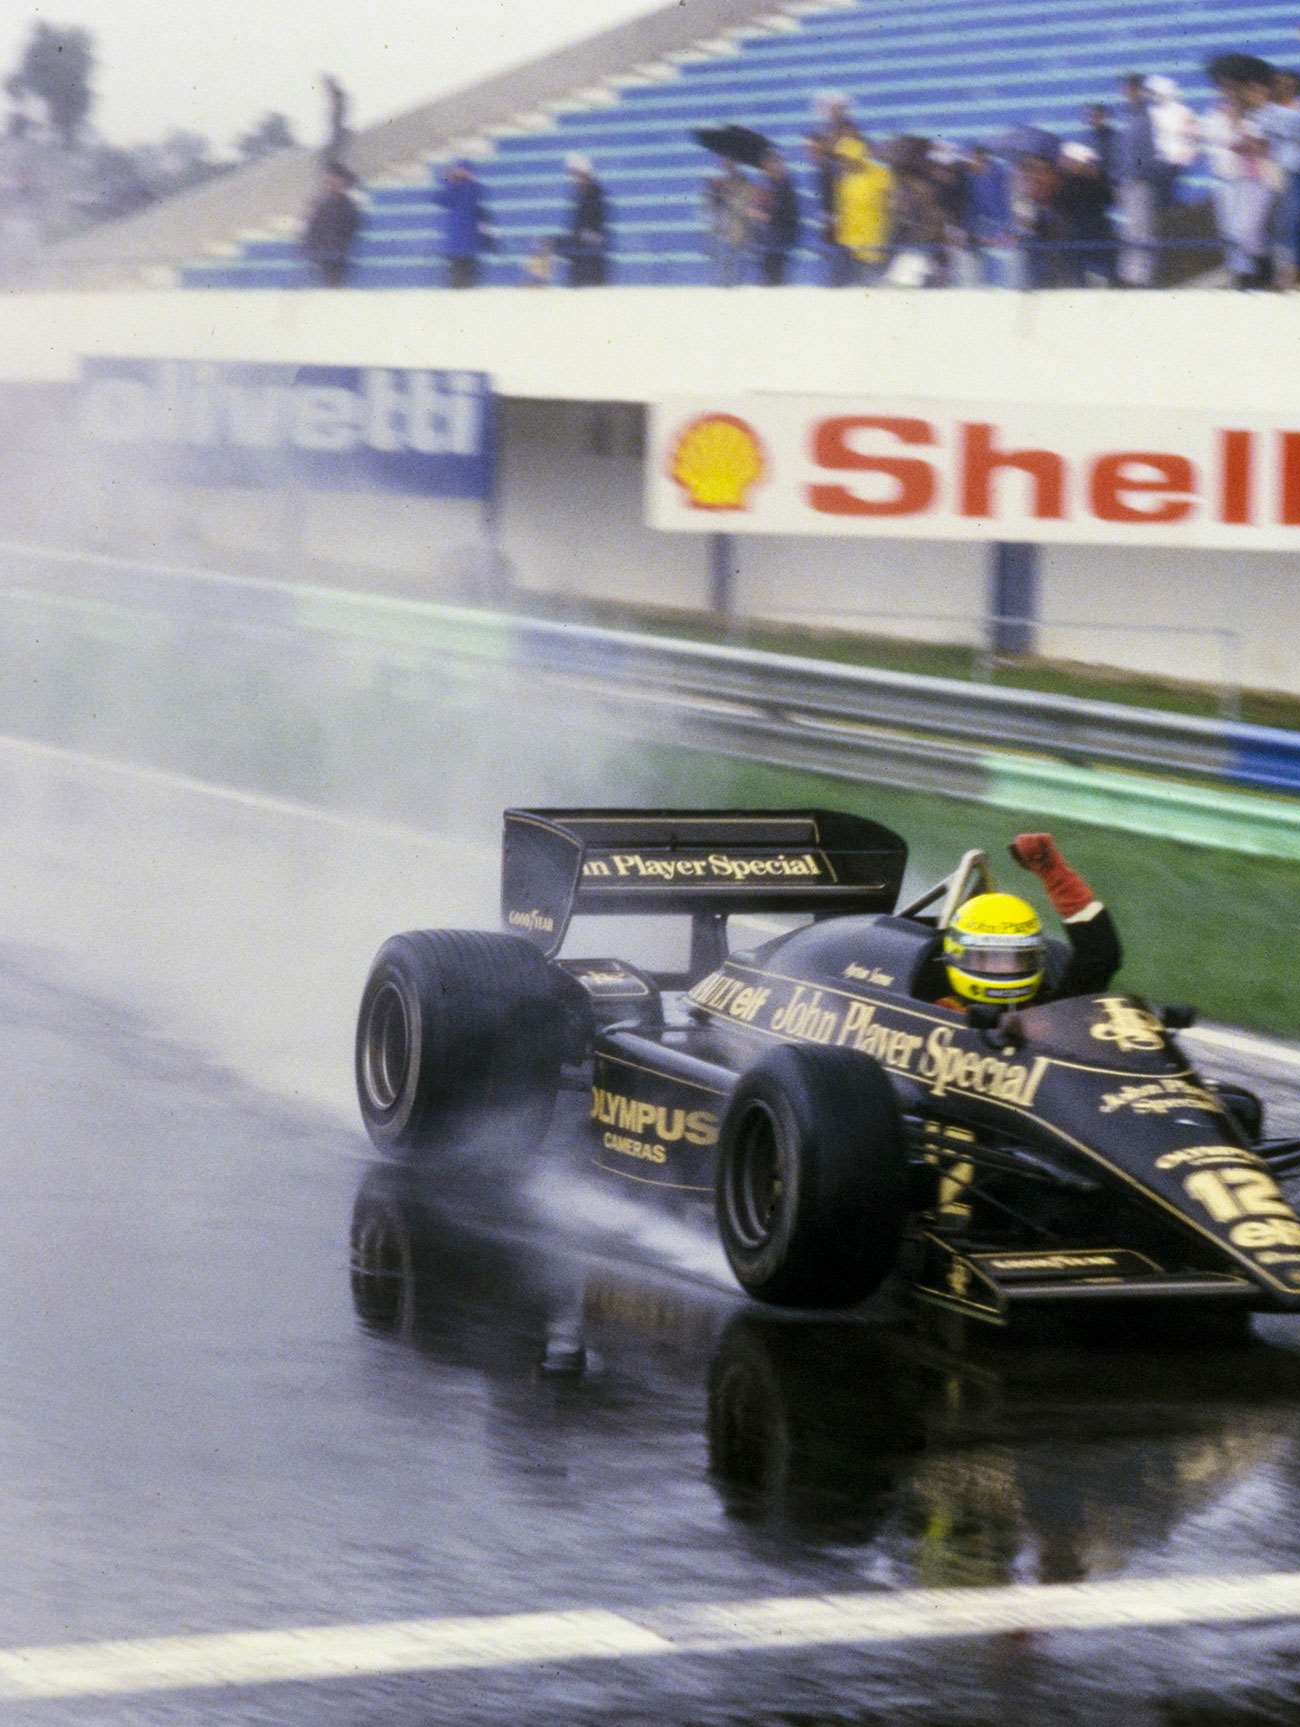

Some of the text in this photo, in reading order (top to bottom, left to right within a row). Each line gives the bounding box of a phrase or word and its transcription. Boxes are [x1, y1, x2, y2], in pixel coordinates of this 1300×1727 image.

[612, 854, 706, 880] Player
[707, 853, 820, 880] Special
[770, 985, 838, 1045] John
[836, 1000, 924, 1070] Player
[918, 1026, 1048, 1108] Special
[603, 1131, 667, 1163] CAMERAS
[1183, 1167, 1297, 1224] 12
